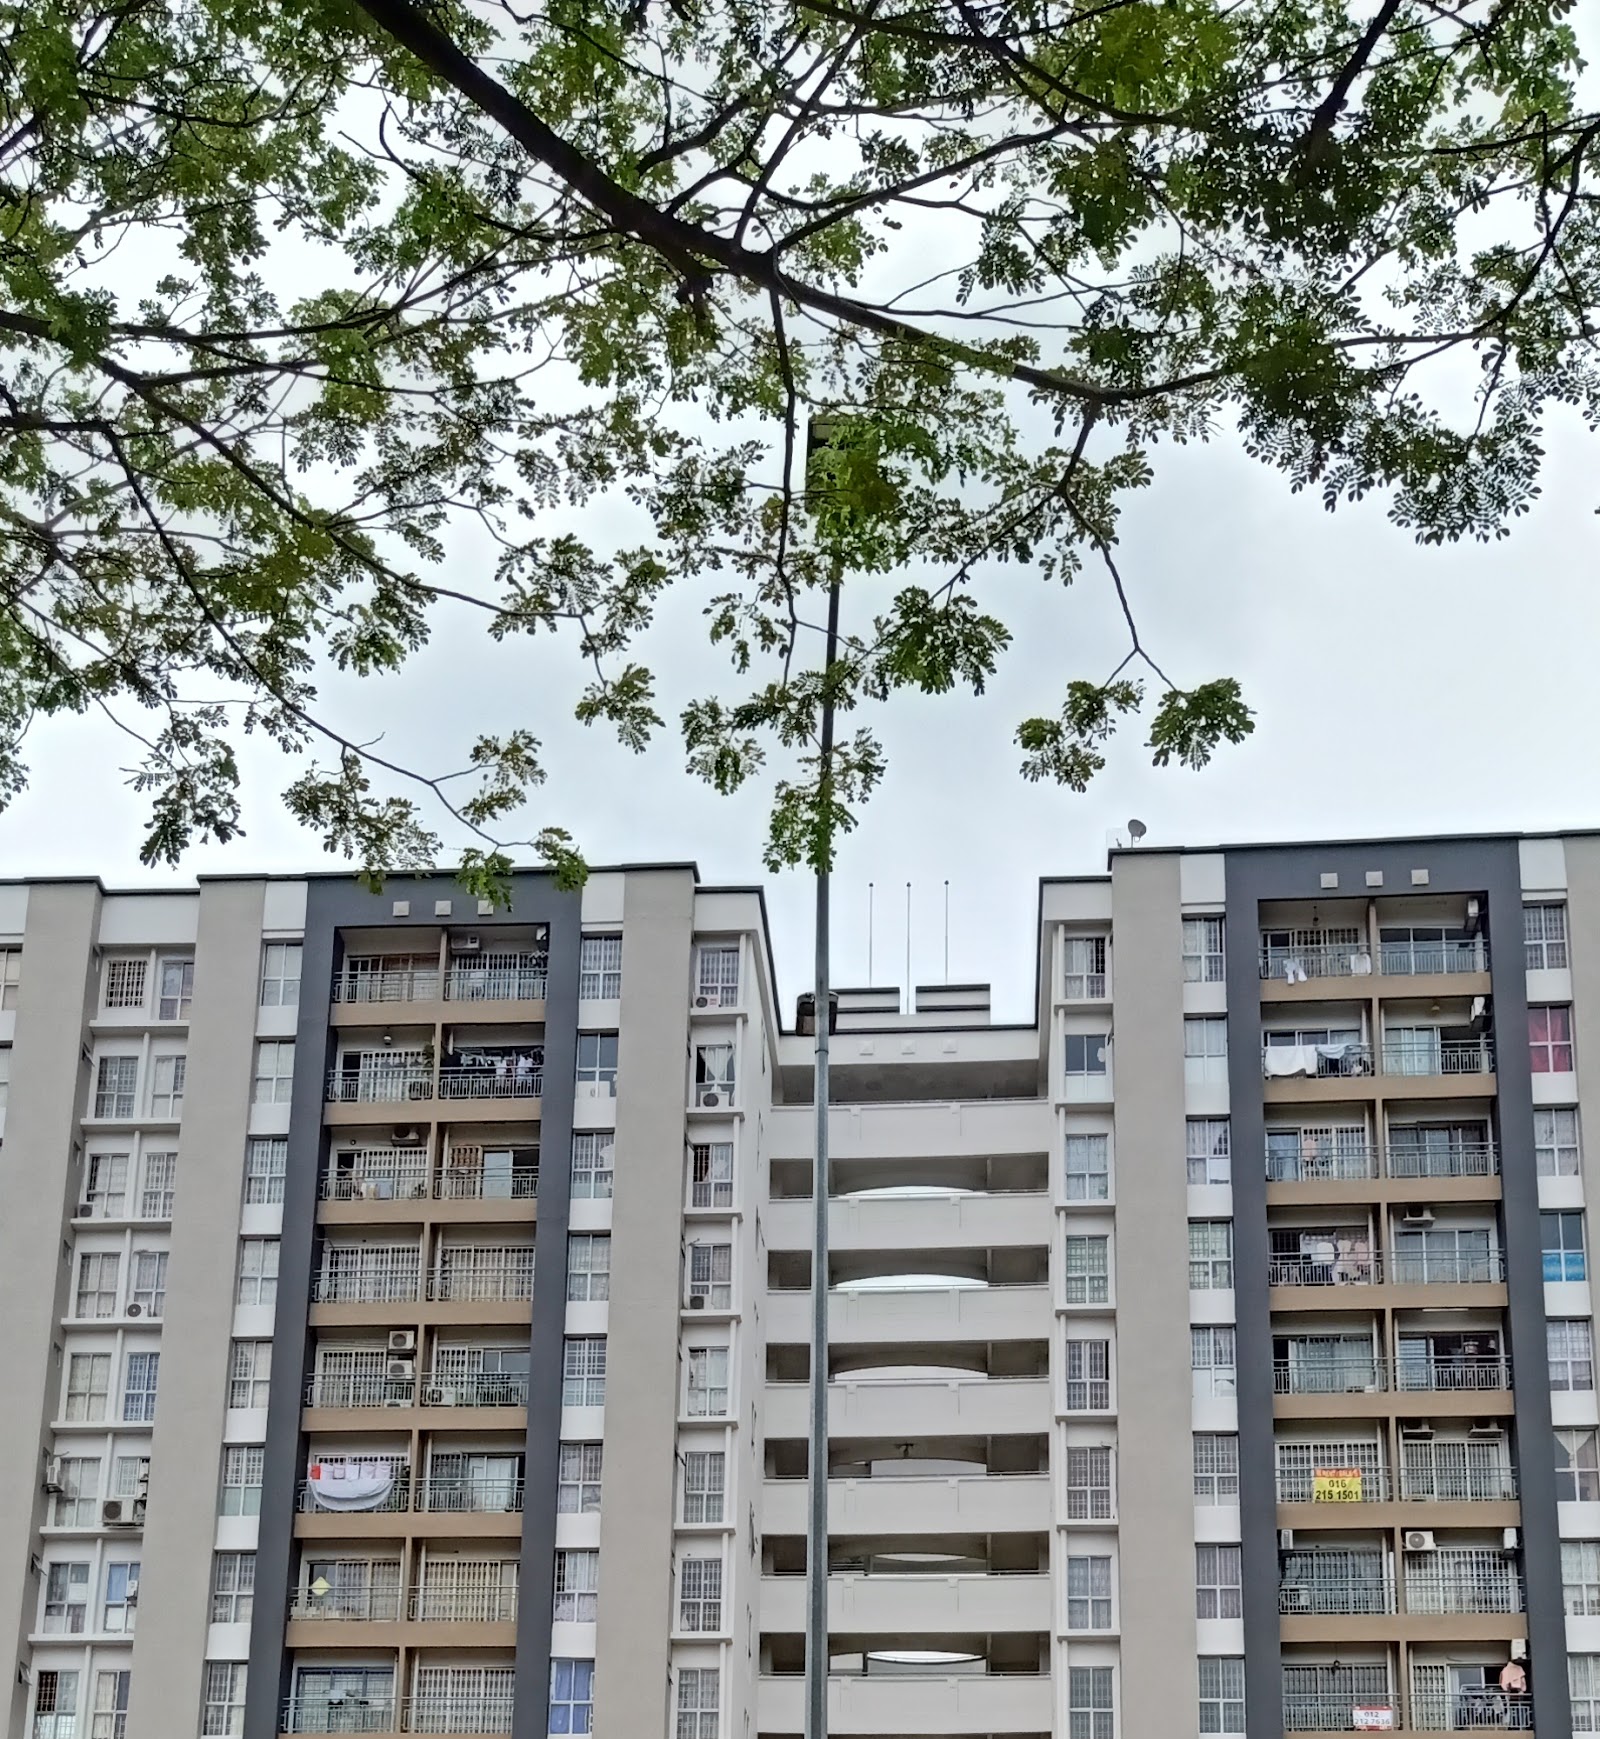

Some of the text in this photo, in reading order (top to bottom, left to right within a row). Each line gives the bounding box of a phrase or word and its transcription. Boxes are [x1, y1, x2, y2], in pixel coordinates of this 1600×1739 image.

[1329, 1480, 1346, 1488] 016
[1316, 1490, 1358, 1499] 215 1501
